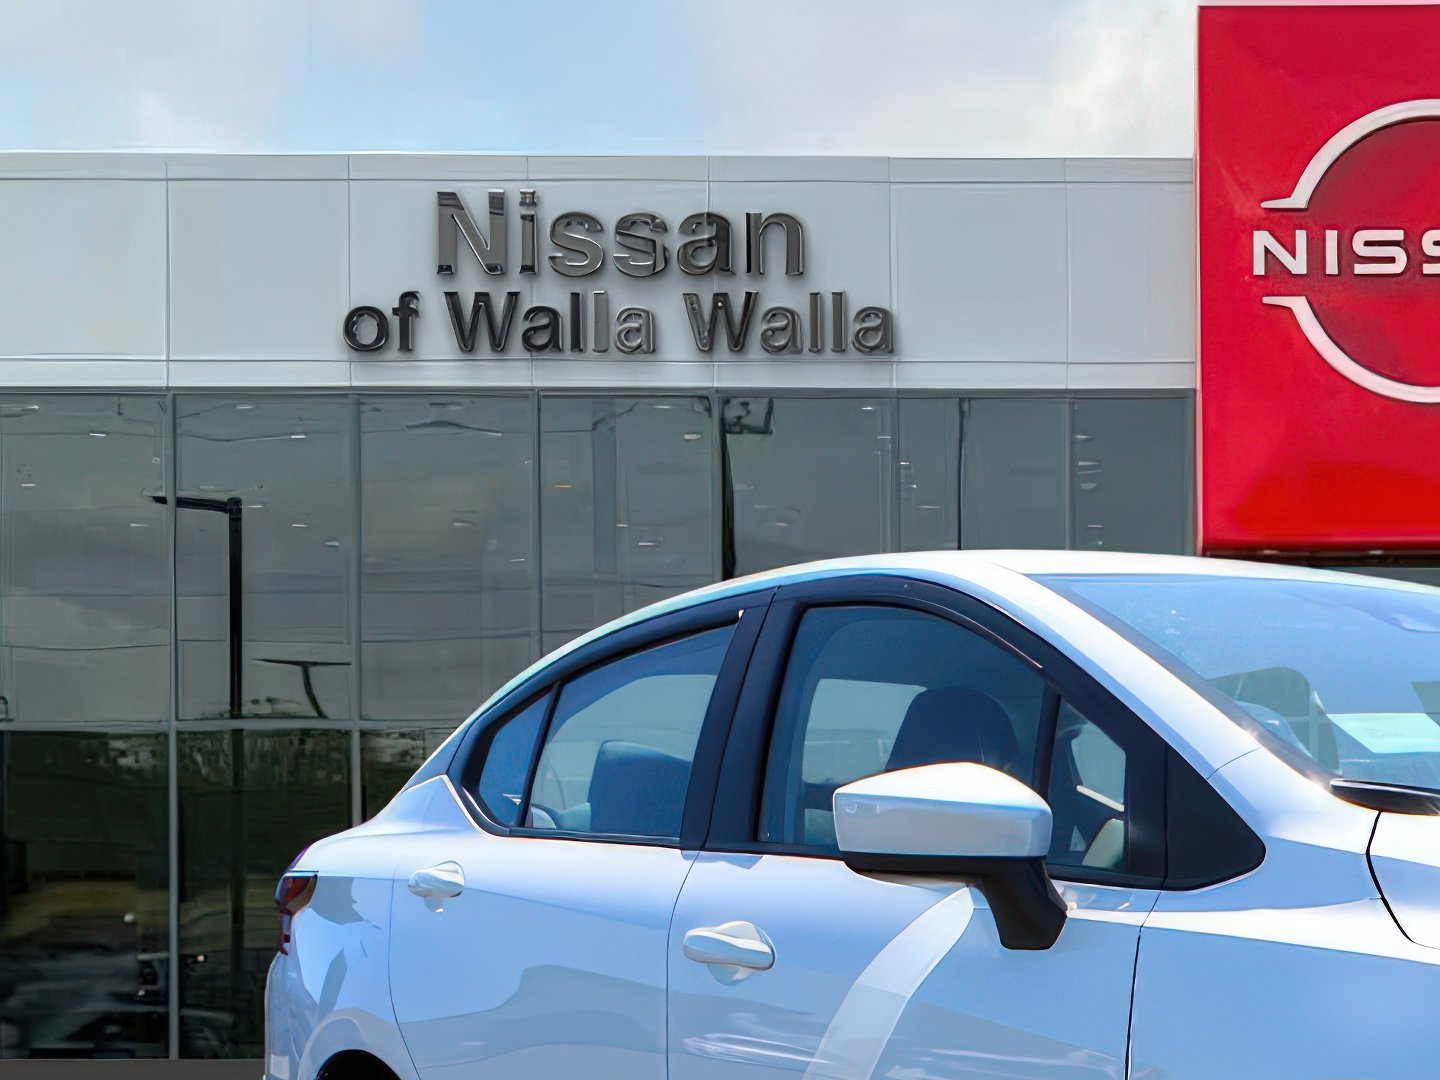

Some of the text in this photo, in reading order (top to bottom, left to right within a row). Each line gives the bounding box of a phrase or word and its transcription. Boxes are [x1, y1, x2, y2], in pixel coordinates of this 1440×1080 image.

[437, 188, 804, 276] Nissan
[342, 291, 895, 354] of Walla Walla
